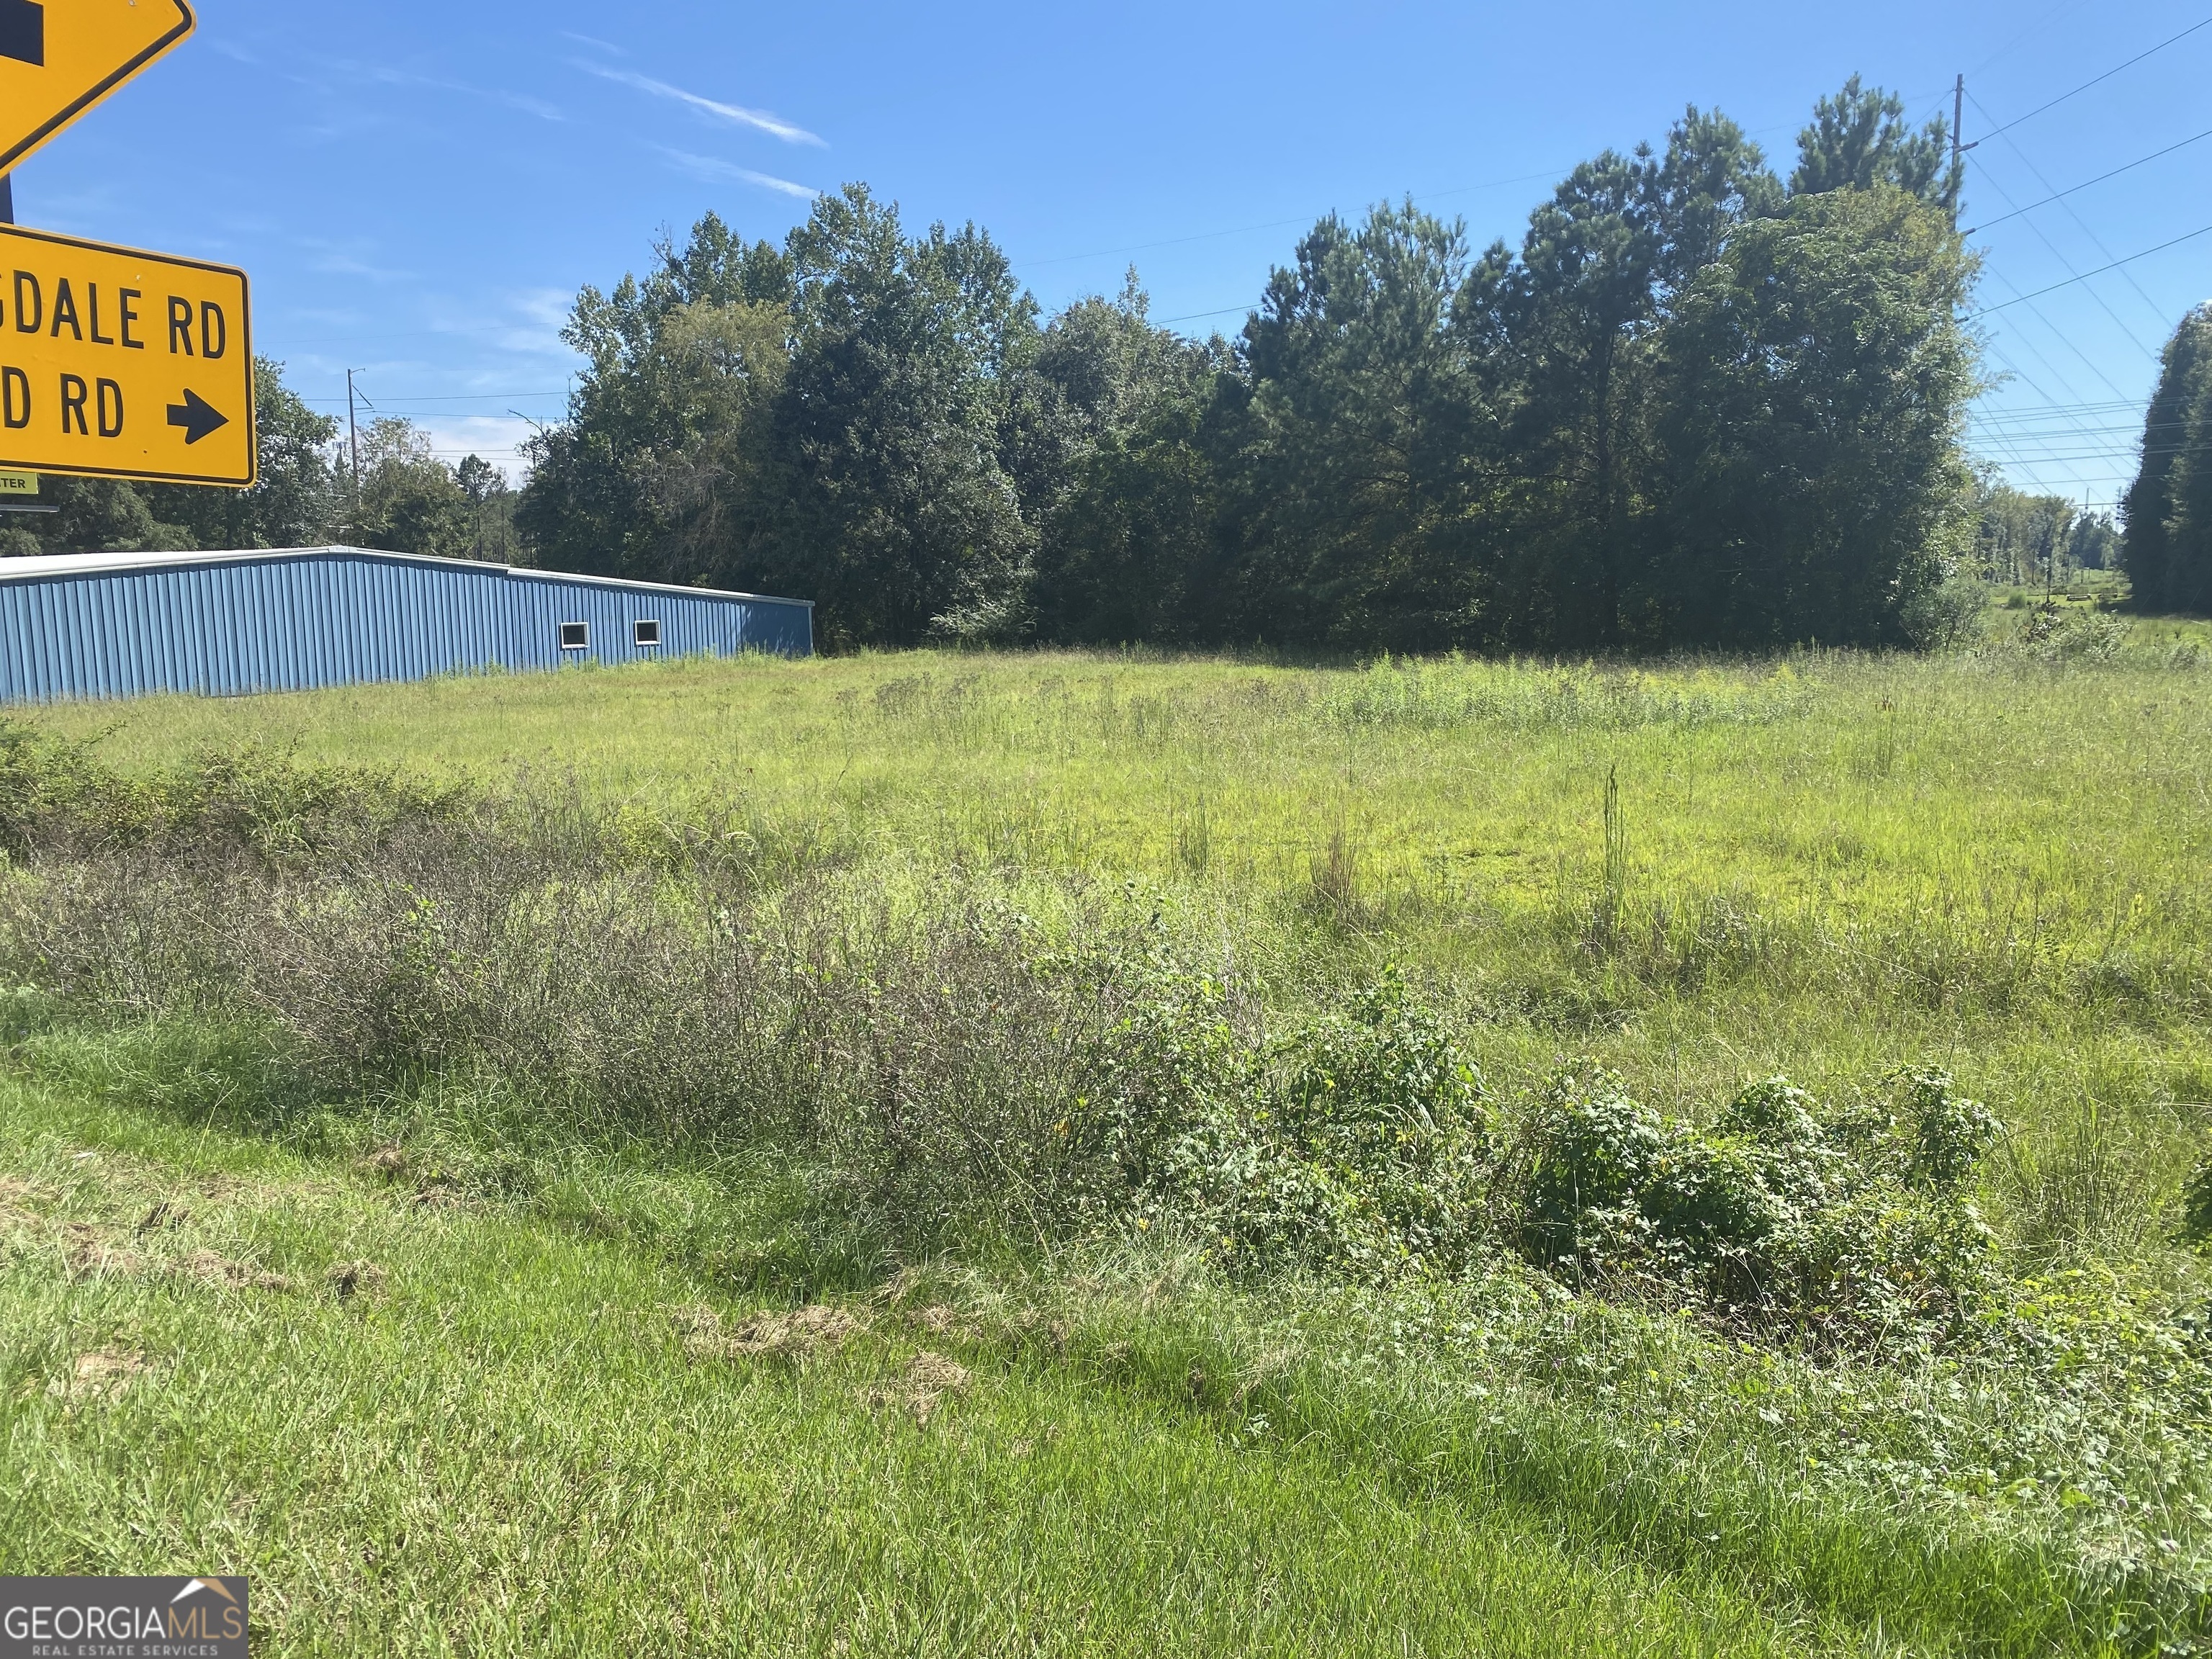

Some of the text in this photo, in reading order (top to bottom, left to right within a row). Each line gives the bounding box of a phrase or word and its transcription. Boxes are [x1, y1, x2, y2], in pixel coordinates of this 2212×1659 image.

[0, 269, 226, 359] DALE RD
[60, 372, 124, 438] RD
[0, 478, 26, 488] TER
